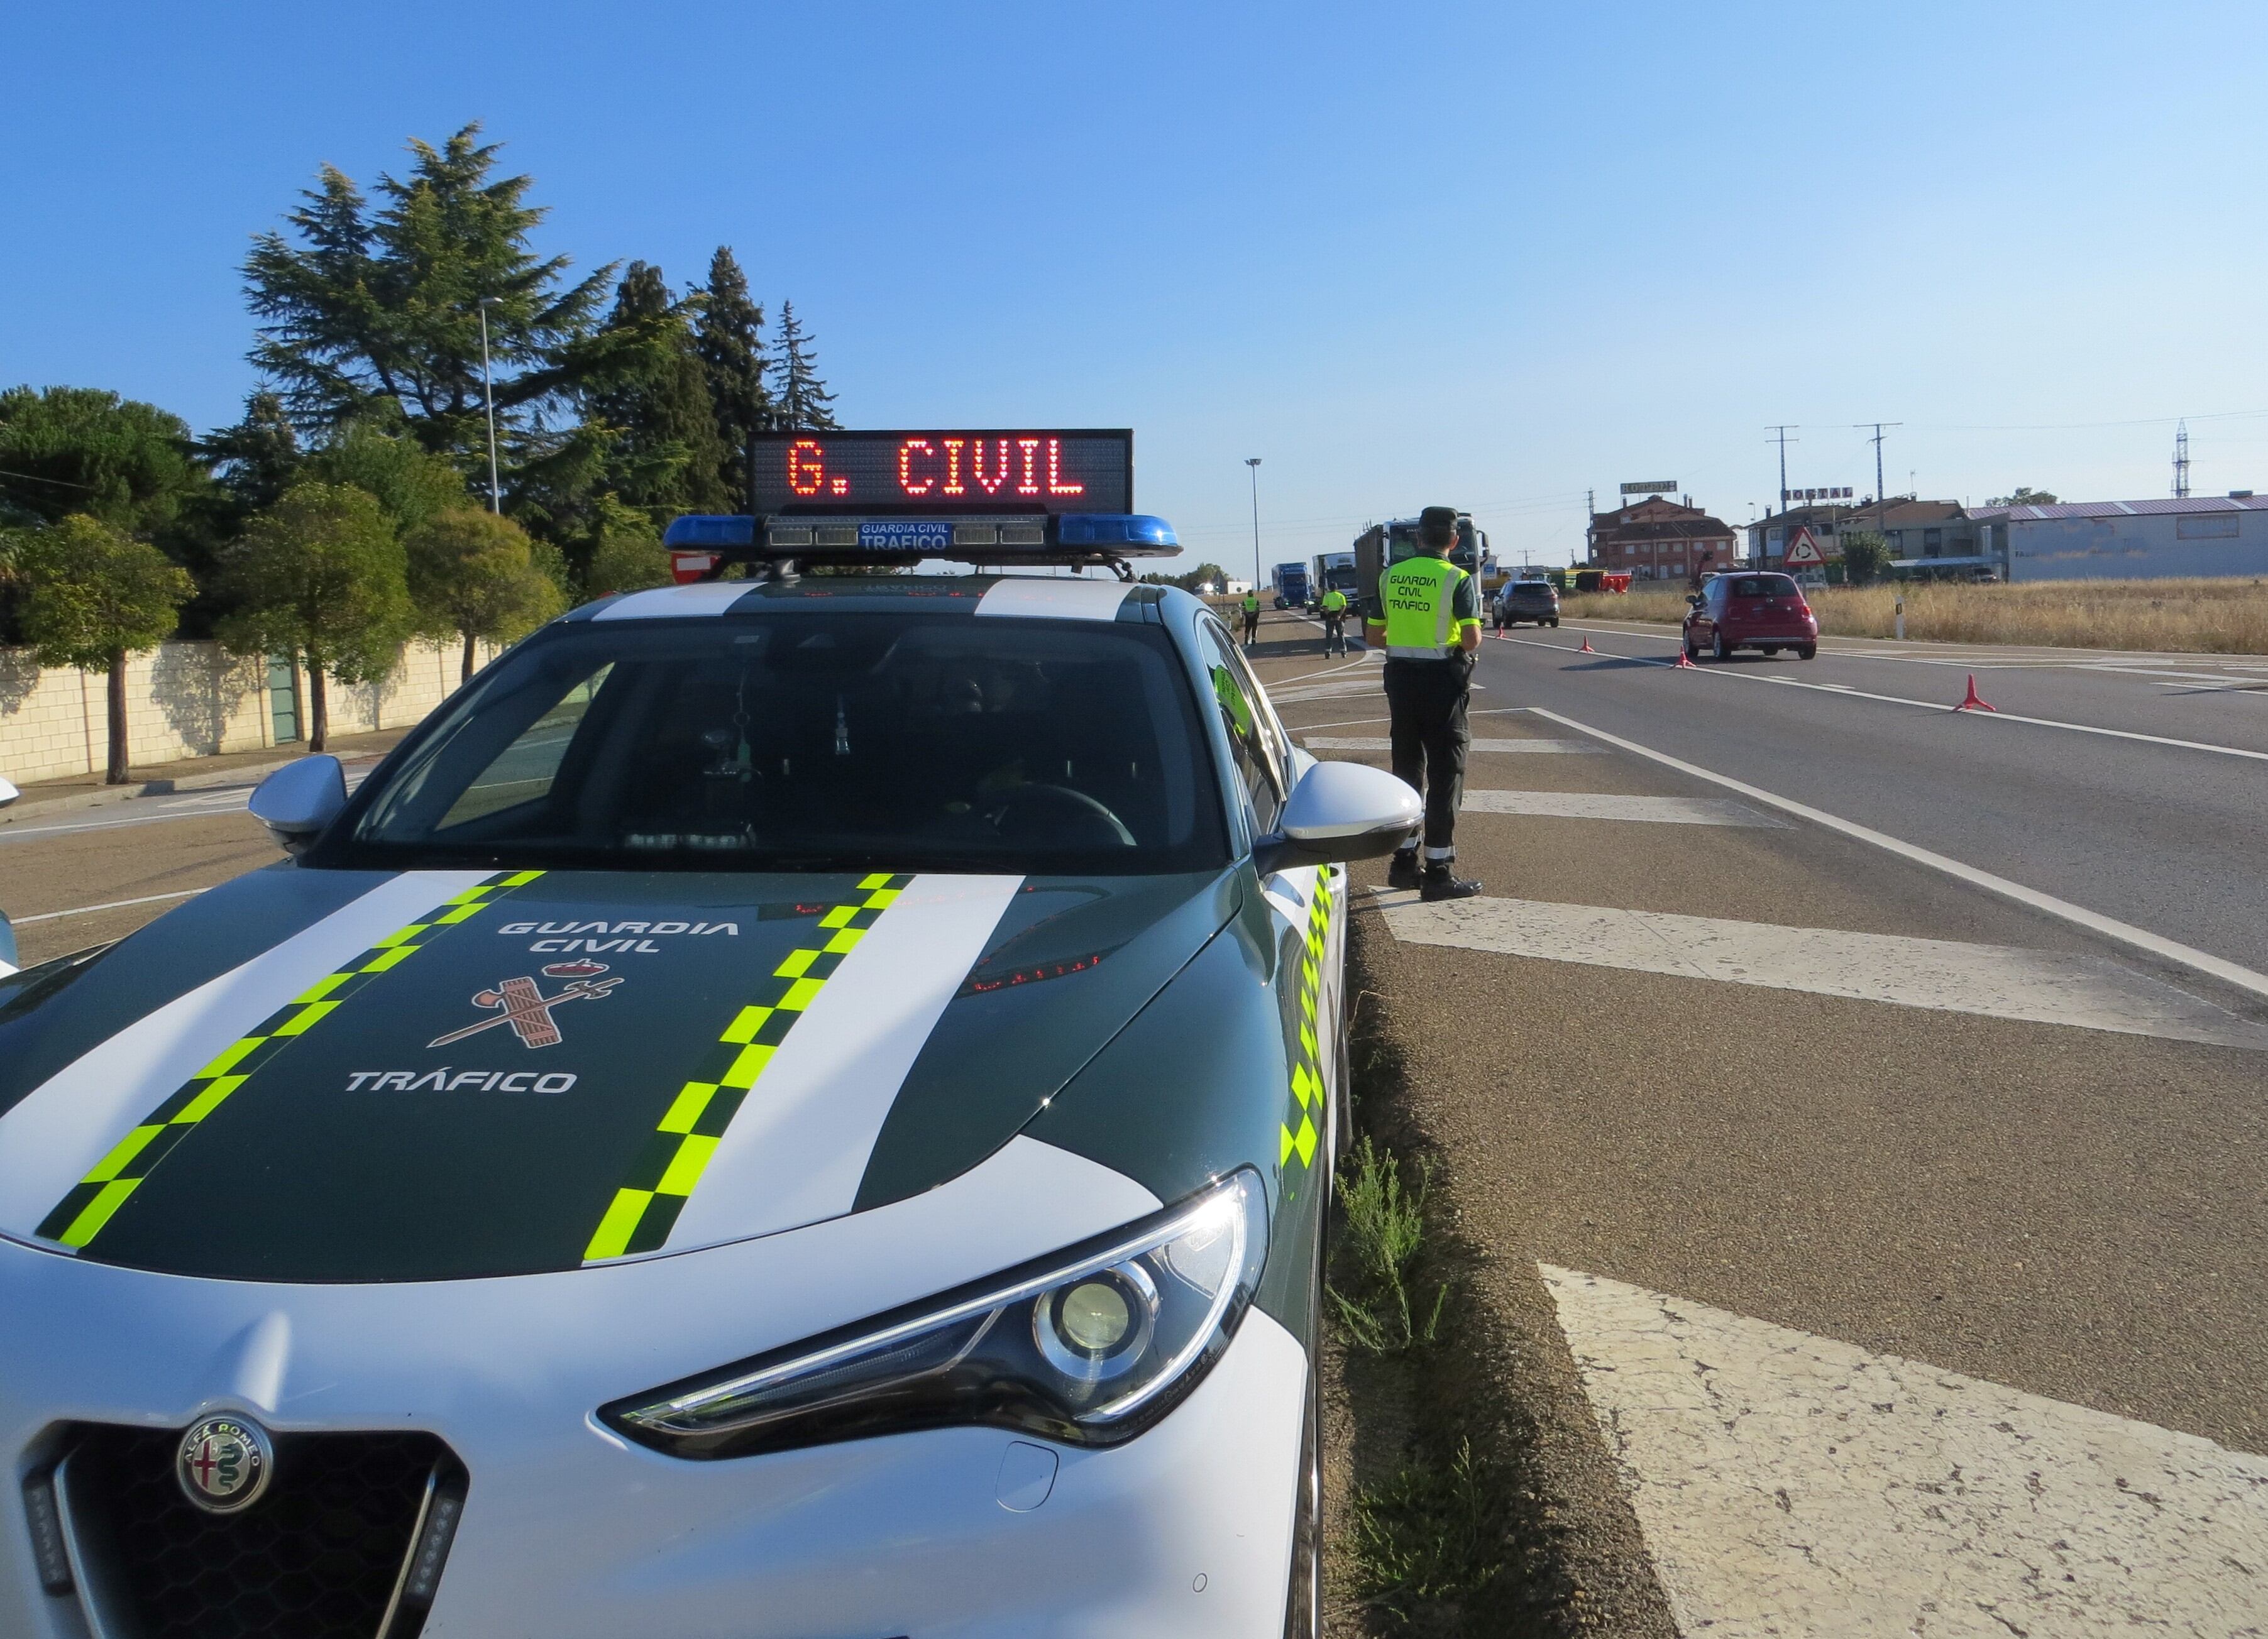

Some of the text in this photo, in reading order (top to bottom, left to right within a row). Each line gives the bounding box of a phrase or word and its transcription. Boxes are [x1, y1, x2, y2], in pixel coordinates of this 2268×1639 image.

[788, 439, 1083, 495] G. CIVIL
[862, 524, 948, 533] GUARDIA CIVIL
[861, 535, 947, 551] TRAFICO
[1390, 575, 1436, 588] GUARDIA
[1398, 586, 1422, 597] CIVIL
[1389, 598, 1430, 611] TRÁFICO
[498, 921, 739, 936] GUARDIA
[529, 939, 661, 953] CIVIL
[345, 1066, 578, 1094] TRÁFICO
[185, 1423, 260, 1466] ALFA ROMEO
